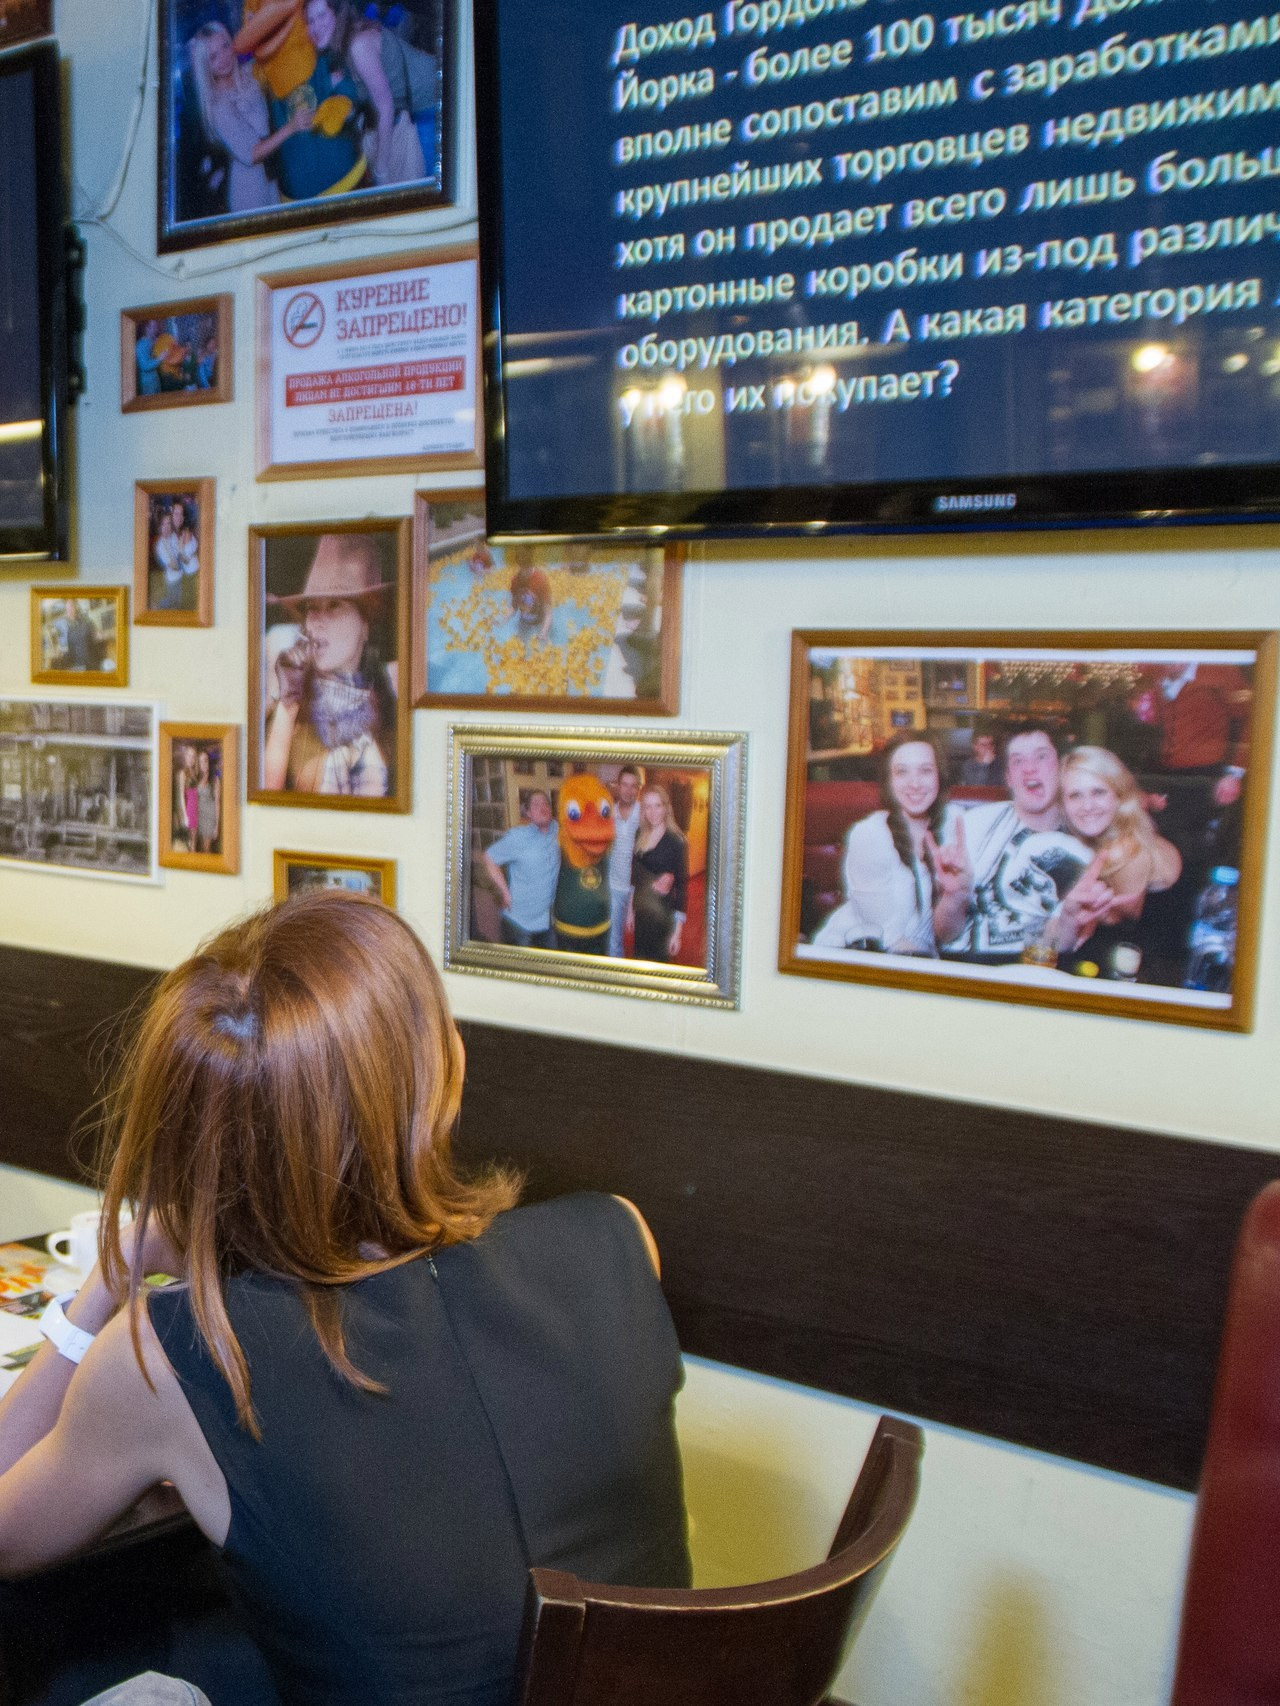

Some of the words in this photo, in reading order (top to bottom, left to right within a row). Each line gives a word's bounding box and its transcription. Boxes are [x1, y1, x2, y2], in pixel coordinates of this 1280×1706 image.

[610, 13, 717, 69] Доход
[613, 68, 716, 113] Йорка
[743, 39, 854, 87] более
[864, 14, 935, 63] 100
[942, 0, 1062, 46] тысяч
[613, 117, 733, 167] вполне
[738, 77, 958, 142] сопоставим
[968, 69, 996, 101] с
[614, 159, 824, 221] крупнейших
[831, 123, 1030, 184] торговцев
[614, 232, 686, 269] хотя
[691, 226, 737, 258] он
[743, 203, 894, 256] продает
[898, 187, 1007, 230] всего
[1016, 169, 1137, 215] лишь
[335, 277, 431, 313] КУРЕНИЕ
[615, 272, 796, 324] картонные
[804, 248, 964, 299] коробки
[973, 231, 1119, 281] из-под
[335, 302, 468, 341] ЗАПРЕЩЕНО!
[618, 320, 870, 371] оборудования.
[879, 307, 912, 346] А
[918, 302, 1027, 342] какая
[1038, 277, 1262, 326] категория
[288, 374, 333, 391] ПРОДАЖА
[335, 366, 402, 385] АЛКОГОЛЬНОЙ
[723, 384, 766, 415] их
[328, 401, 419, 424] ЗАПРЕЩЕНА!
[935, 493, 1017, 511] SAMSUNG
